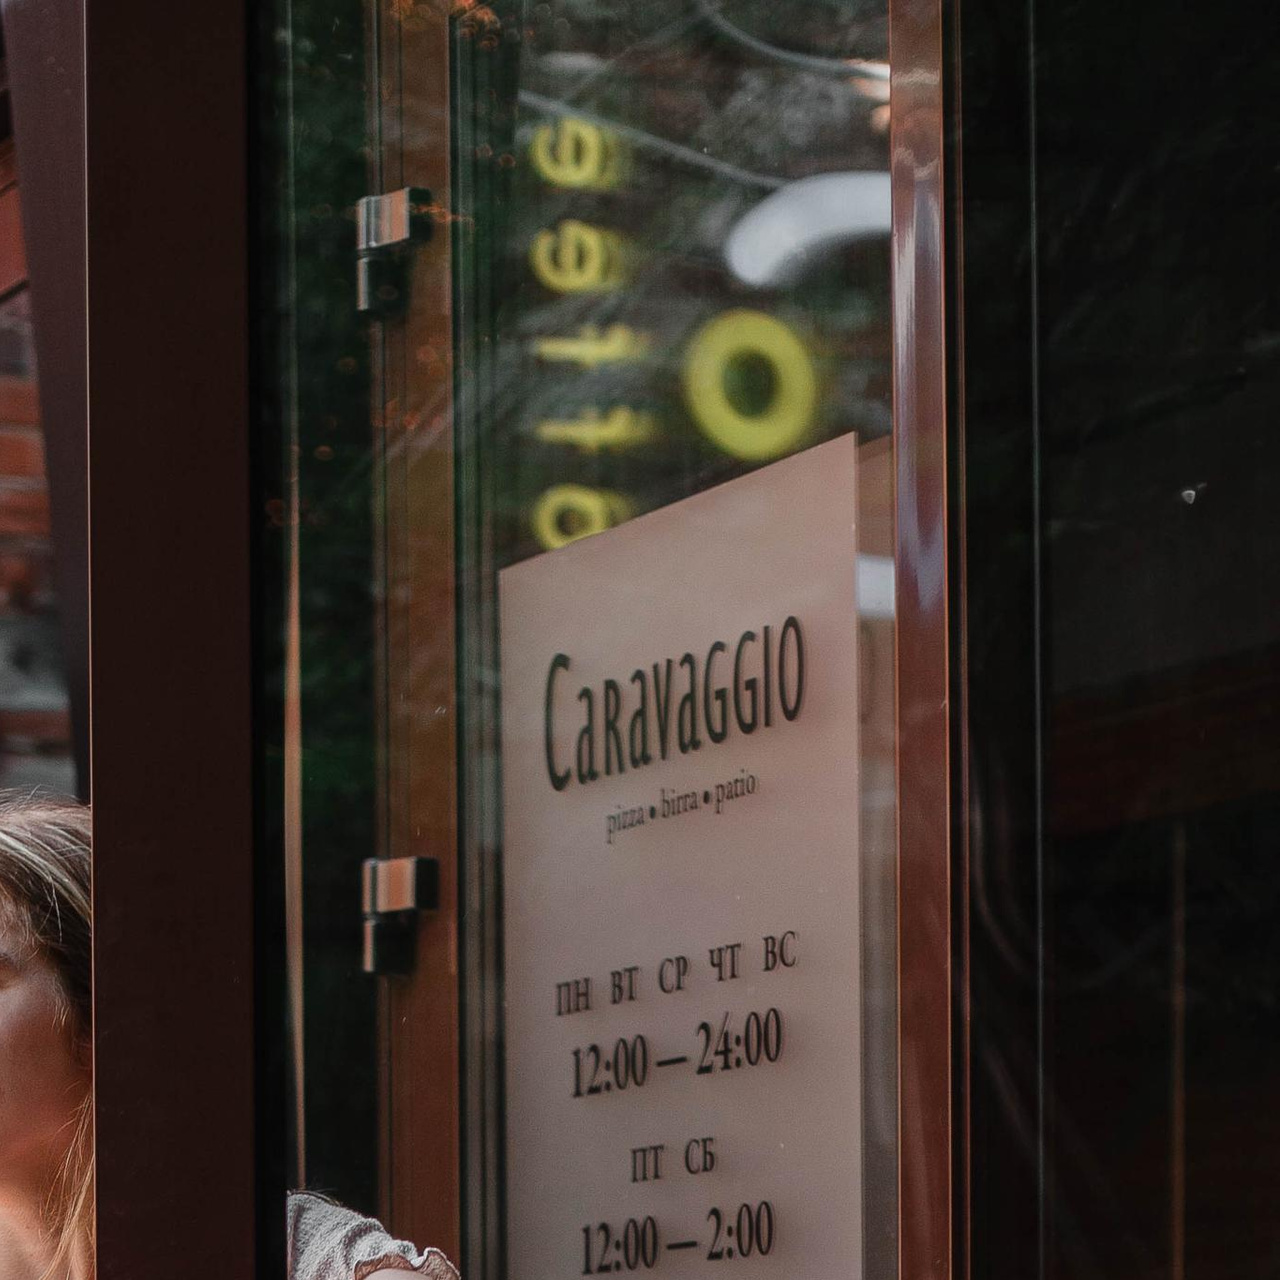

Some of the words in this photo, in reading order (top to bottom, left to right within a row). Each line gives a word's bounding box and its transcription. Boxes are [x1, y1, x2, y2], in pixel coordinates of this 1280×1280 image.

[606, 805, 645, 844] pizza
[660, 788, 699, 818] birra
[715, 769, 756, 814] patio
[555, 977, 591, 1016] ПН
[610, 966, 639, 1004] ВТ
[658, 955, 689, 994] СР
[709, 943, 742, 982] ЧТ
[763, 930, 798, 971] ВС
[631, 1145, 664, 1183] ПТ
[684, 1138, 715, 1175] СБ
